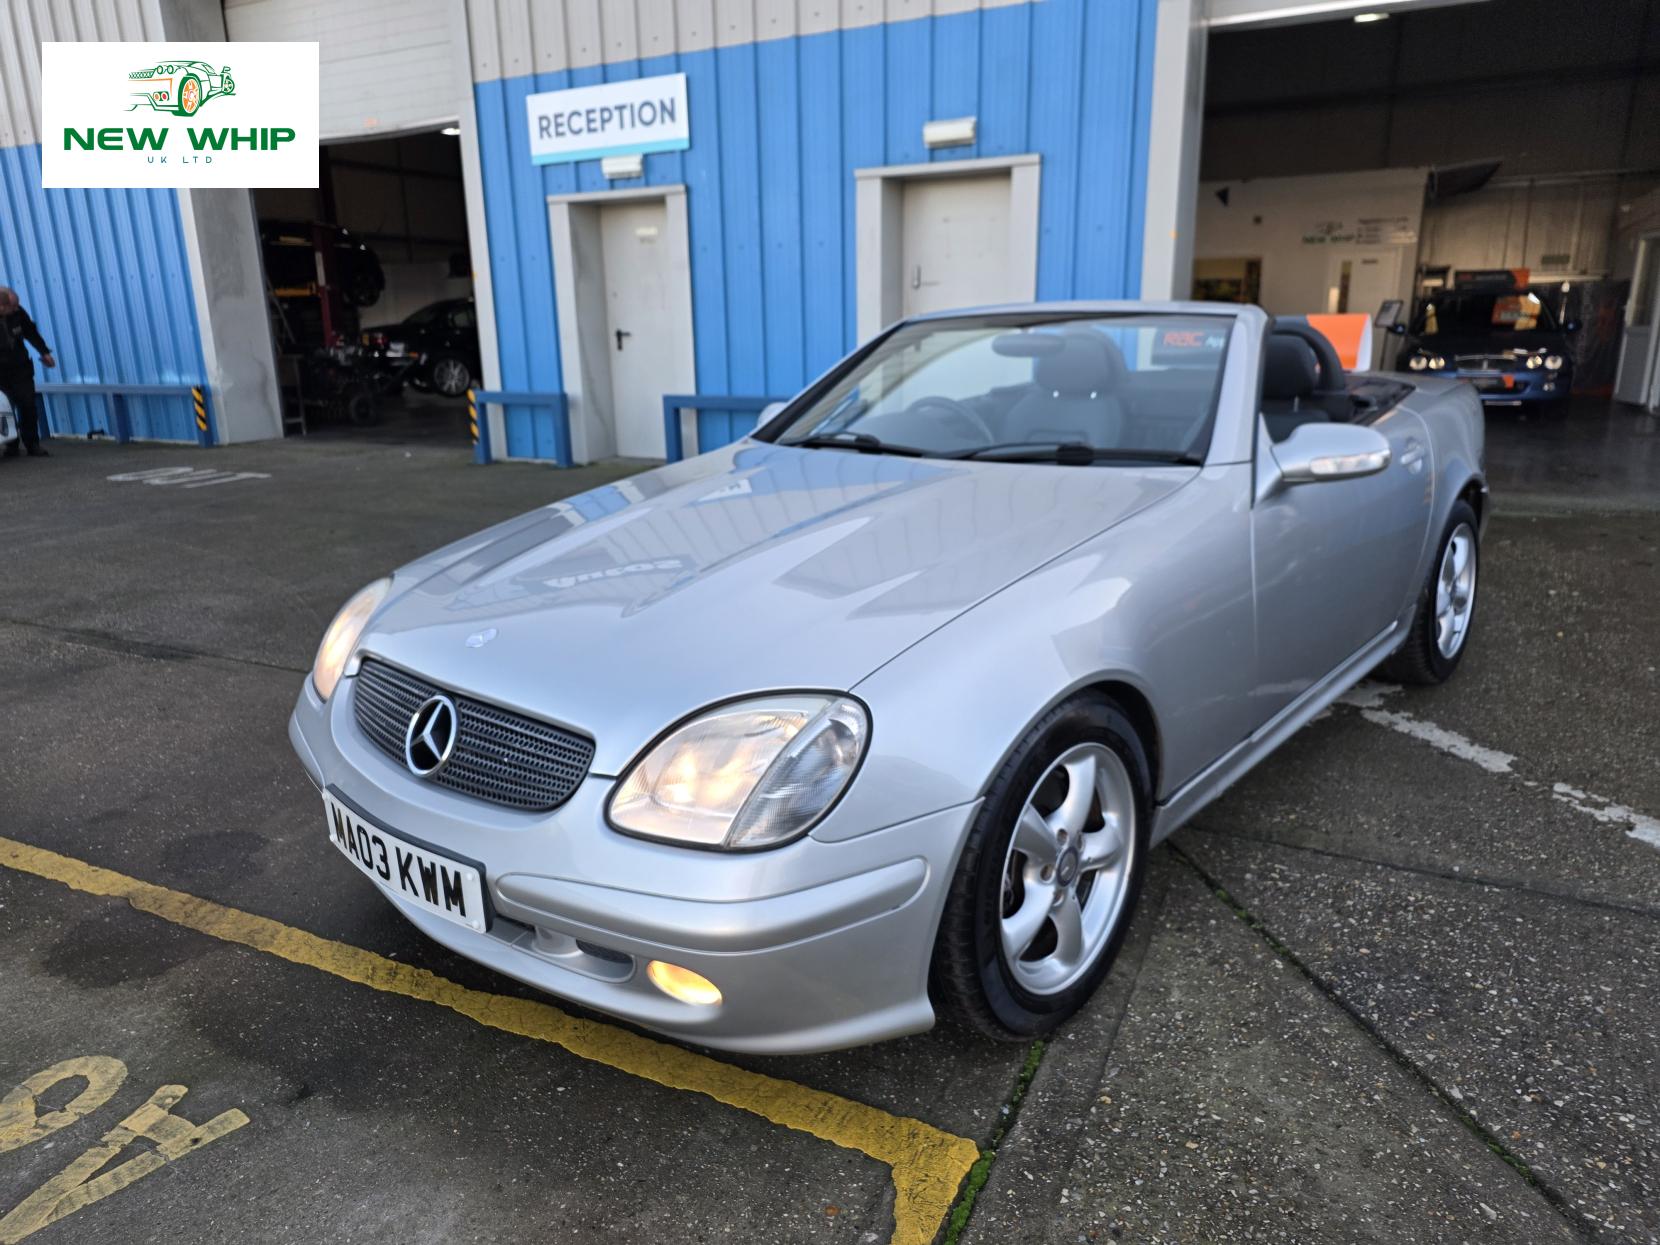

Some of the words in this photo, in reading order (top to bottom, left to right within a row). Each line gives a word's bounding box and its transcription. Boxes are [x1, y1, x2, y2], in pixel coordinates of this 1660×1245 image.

[538, 98, 676, 139] RECEPTION
[331, 801, 391, 881] MA03
[395, 846, 467, 918] KWM
